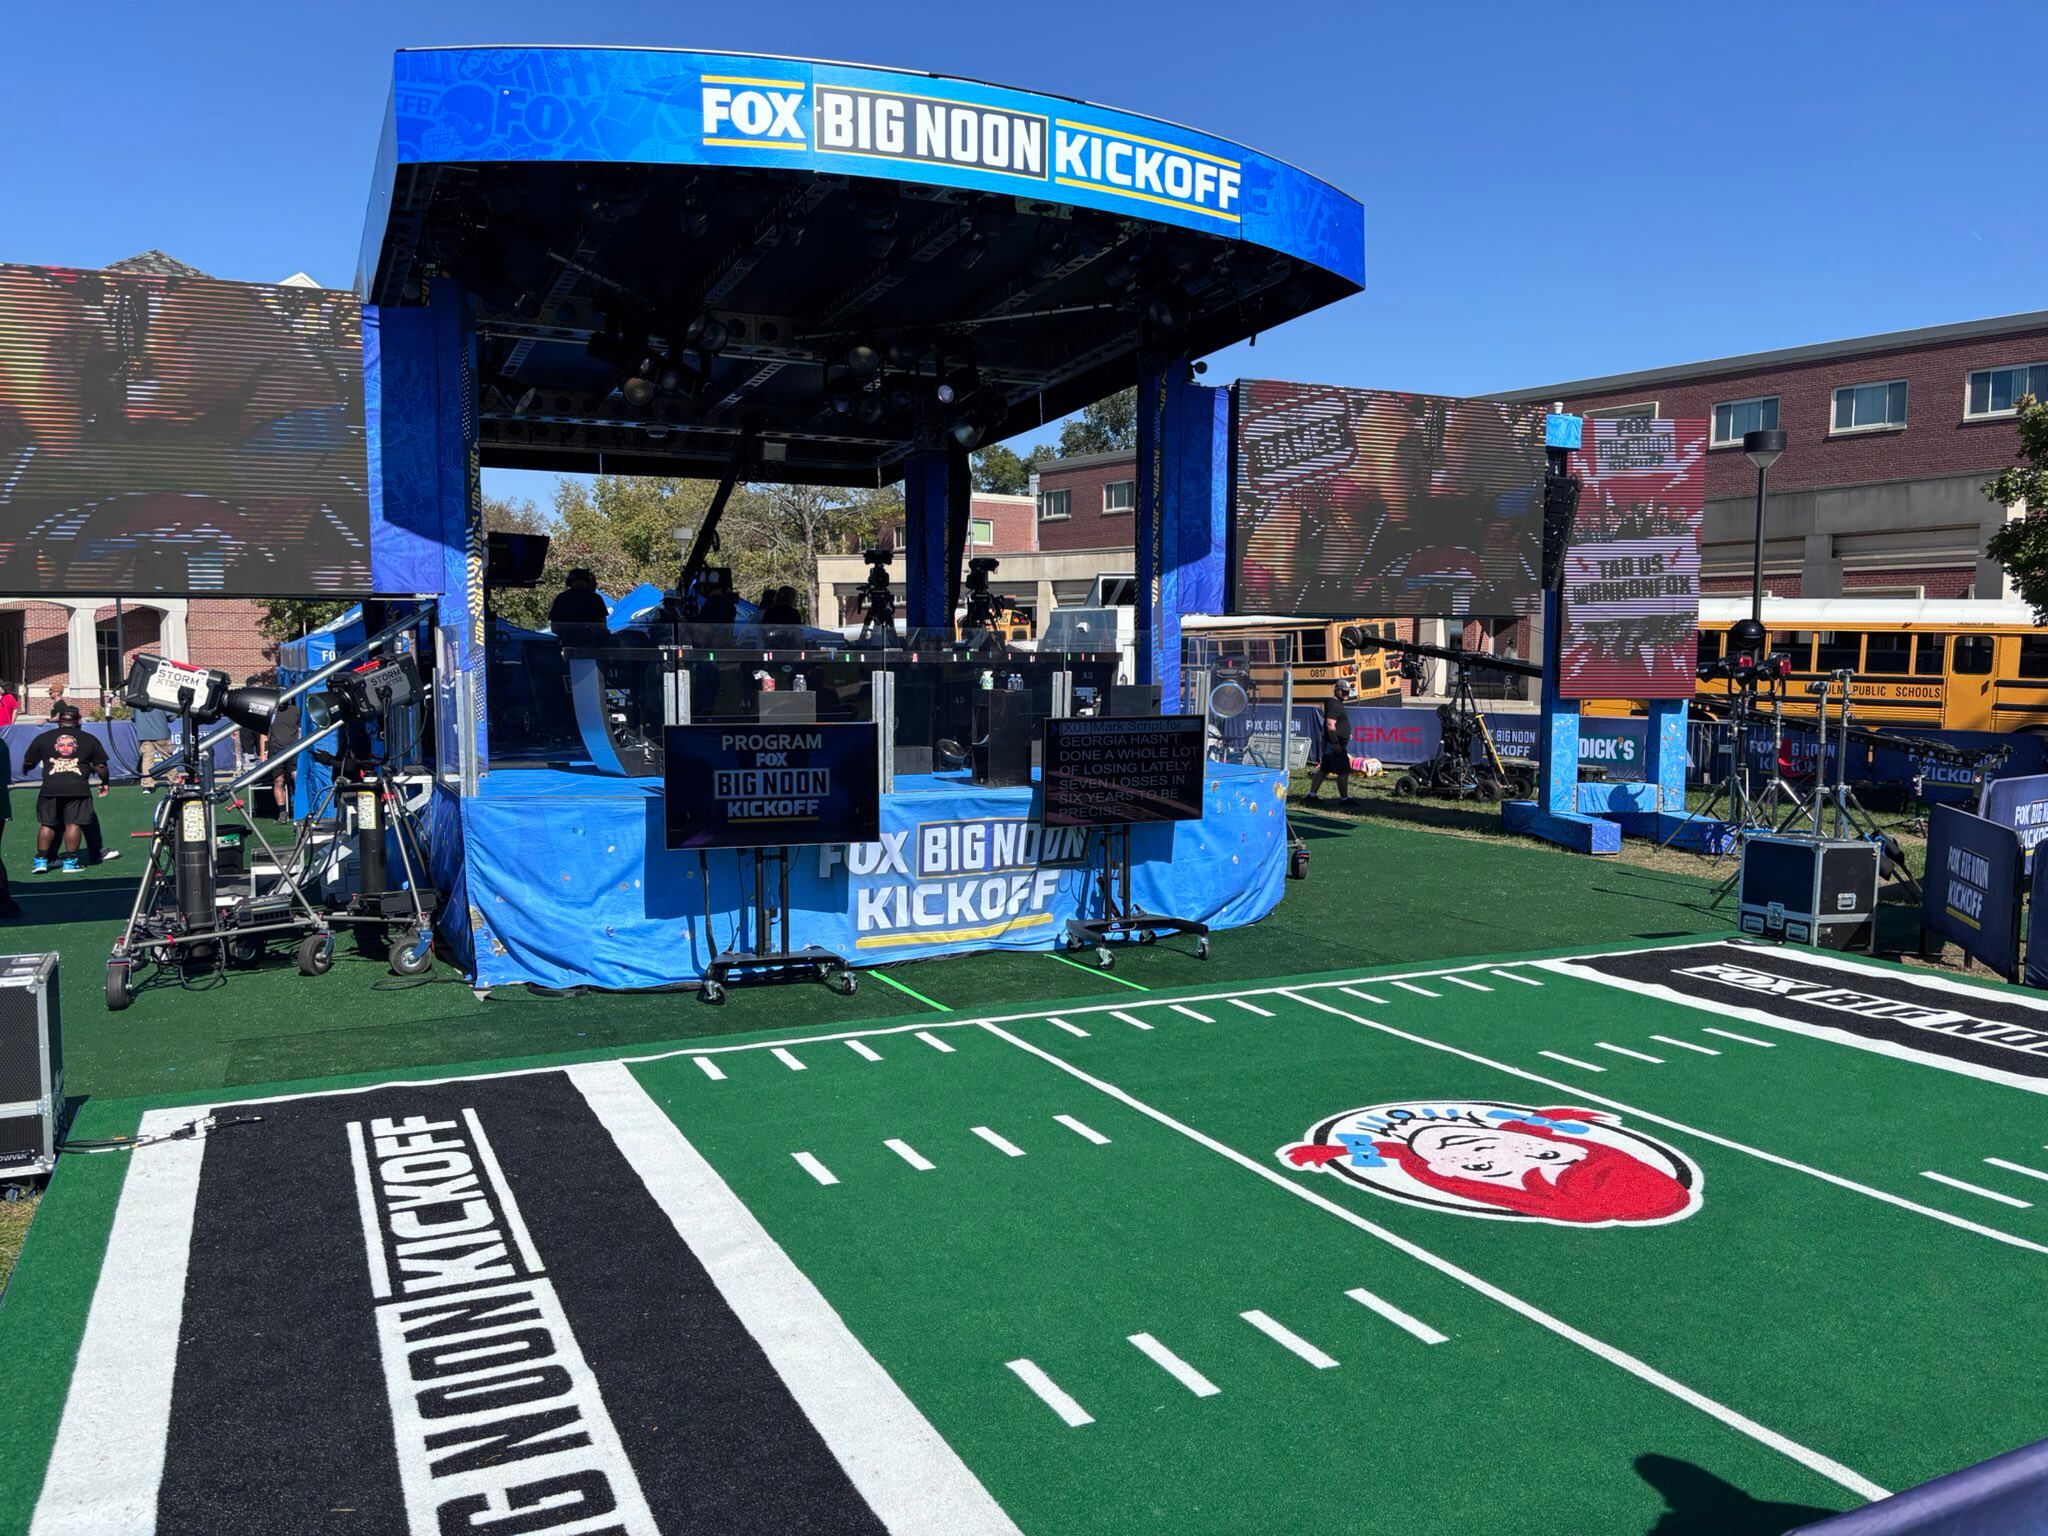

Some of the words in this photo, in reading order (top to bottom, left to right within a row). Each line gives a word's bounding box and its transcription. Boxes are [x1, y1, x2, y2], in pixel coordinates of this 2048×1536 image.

[702, 88, 806, 139] FOX
[823, 92, 905, 153] BIG
[916, 103, 1042, 173] NOON
[1055, 129, 1241, 210] KICKOFF
[159, 669, 199, 686] STORM
[370, 668, 401, 687] STORM
[1853, 685, 1887, 697] PUBLIC
[1895, 686, 1941, 698] SCHOOLS
[1093, 722, 1124, 733] Mark
[1128, 719, 1162, 733] Script
[1353, 726, 1422, 744] GMC
[721, 733, 823, 751] PROGRAM
[1060, 735, 1128, 748] GEORGIA
[1131, 733, 1181, 745] HASN'T
[1496, 729, 1511, 743] BIG
[1512, 730, 1536, 744] NOON
[1060, 750, 1102, 762] DONE
[1104, 750, 1115, 761] A
[1117, 748, 1169, 760] WHOLE
[1172, 746, 1199, 758] LOT
[1578, 737, 1635, 760] DICK'S
[755, 752, 788, 767] FOX
[1060, 765, 1080, 776] OF
[1084, 763, 1137, 776] LOSING
[717, 771, 757, 796] BIG
[763, 770, 827, 795] NOON
[1060, 778, 1108, 791] SEVEN
[1112, 775, 1168, 789] LOSSES
[1172, 774, 1186, 785] IN
[1059, 792, 1082, 805] SIX
[1088, 790, 1134, 803] YEARS
[1139, 789, 1158, 801] TO
[1161, 788, 1179, 799] BE
[727, 799, 820, 817] KICKOFF
[1059, 805, 1122, 818] PRECISE
[2014, 804, 2031, 826] FOX
[923, 824, 986, 873] BIG
[1947, 845, 1961, 875] FOX
[1971, 855, 1989, 890] NOON
[857, 869, 1061, 931] KICKOFF
[1947, 879, 1983, 919] KICKOFF
[1682, 964, 1811, 994] FOX
[1811, 991, 1948, 1019] BIG
[370, 1115, 517, 1294] KICKOFF
[399, 1290, 593, 1480] NOON
